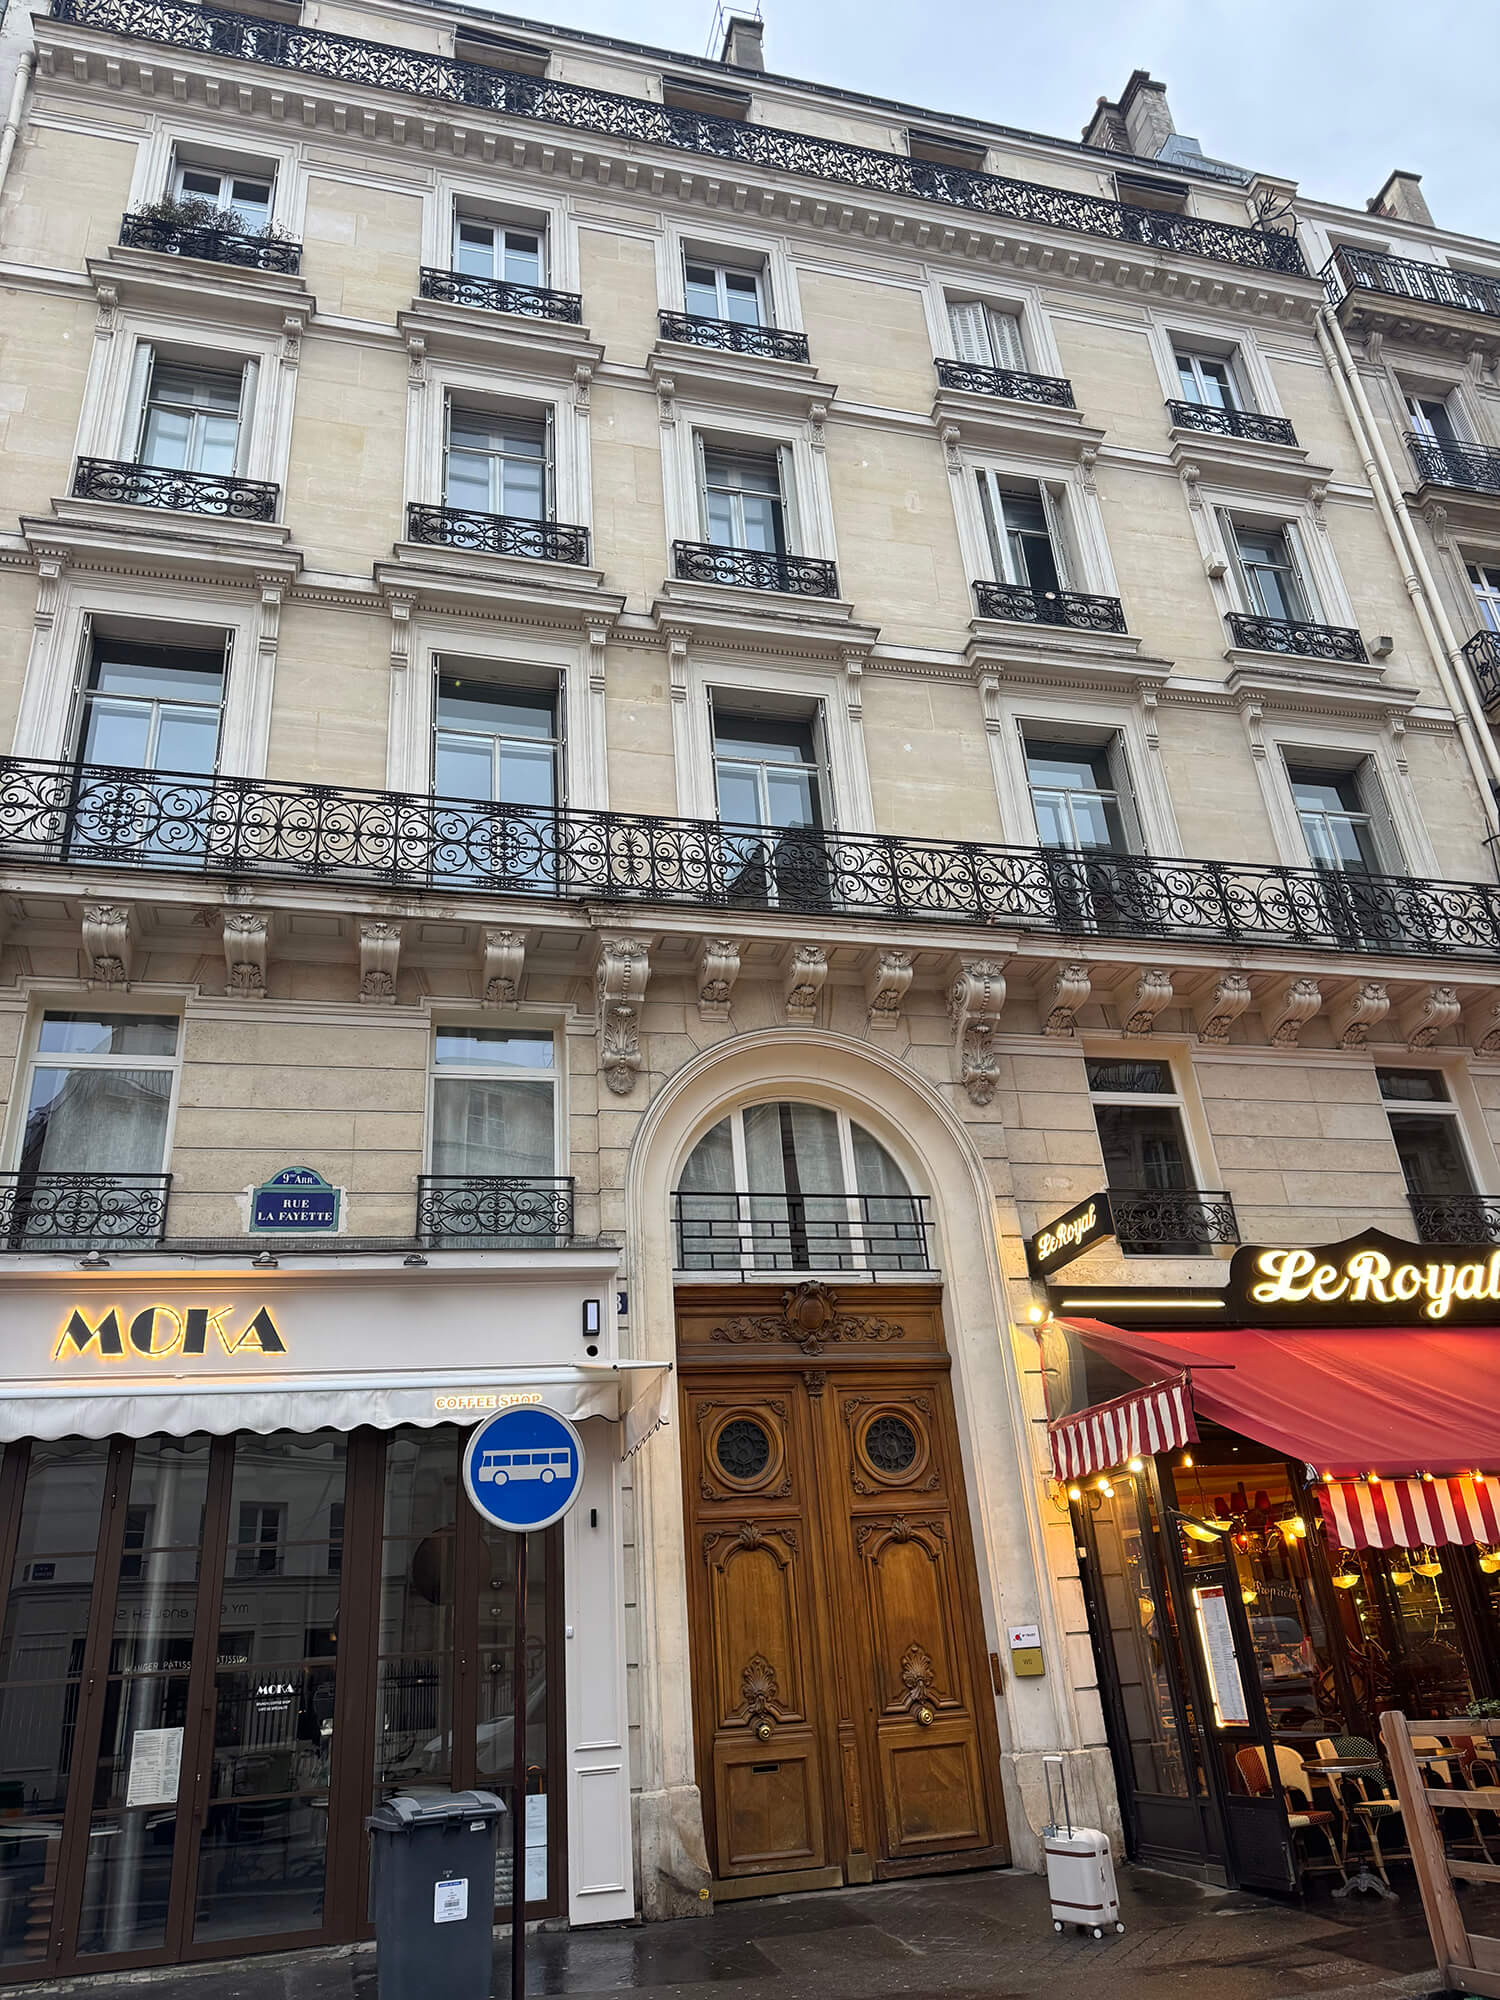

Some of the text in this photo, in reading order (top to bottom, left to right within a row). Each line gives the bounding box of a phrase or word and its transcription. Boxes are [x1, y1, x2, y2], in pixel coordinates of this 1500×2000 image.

[283, 1199, 310, 1209] RUE
[257, 1211, 333, 1221] LA FAYETTE
[54, 1305, 288, 1361] MOKA
[435, 1393, 542, 1409] COFFEE SHOP
[256, 1683, 295, 1696] MOKA
